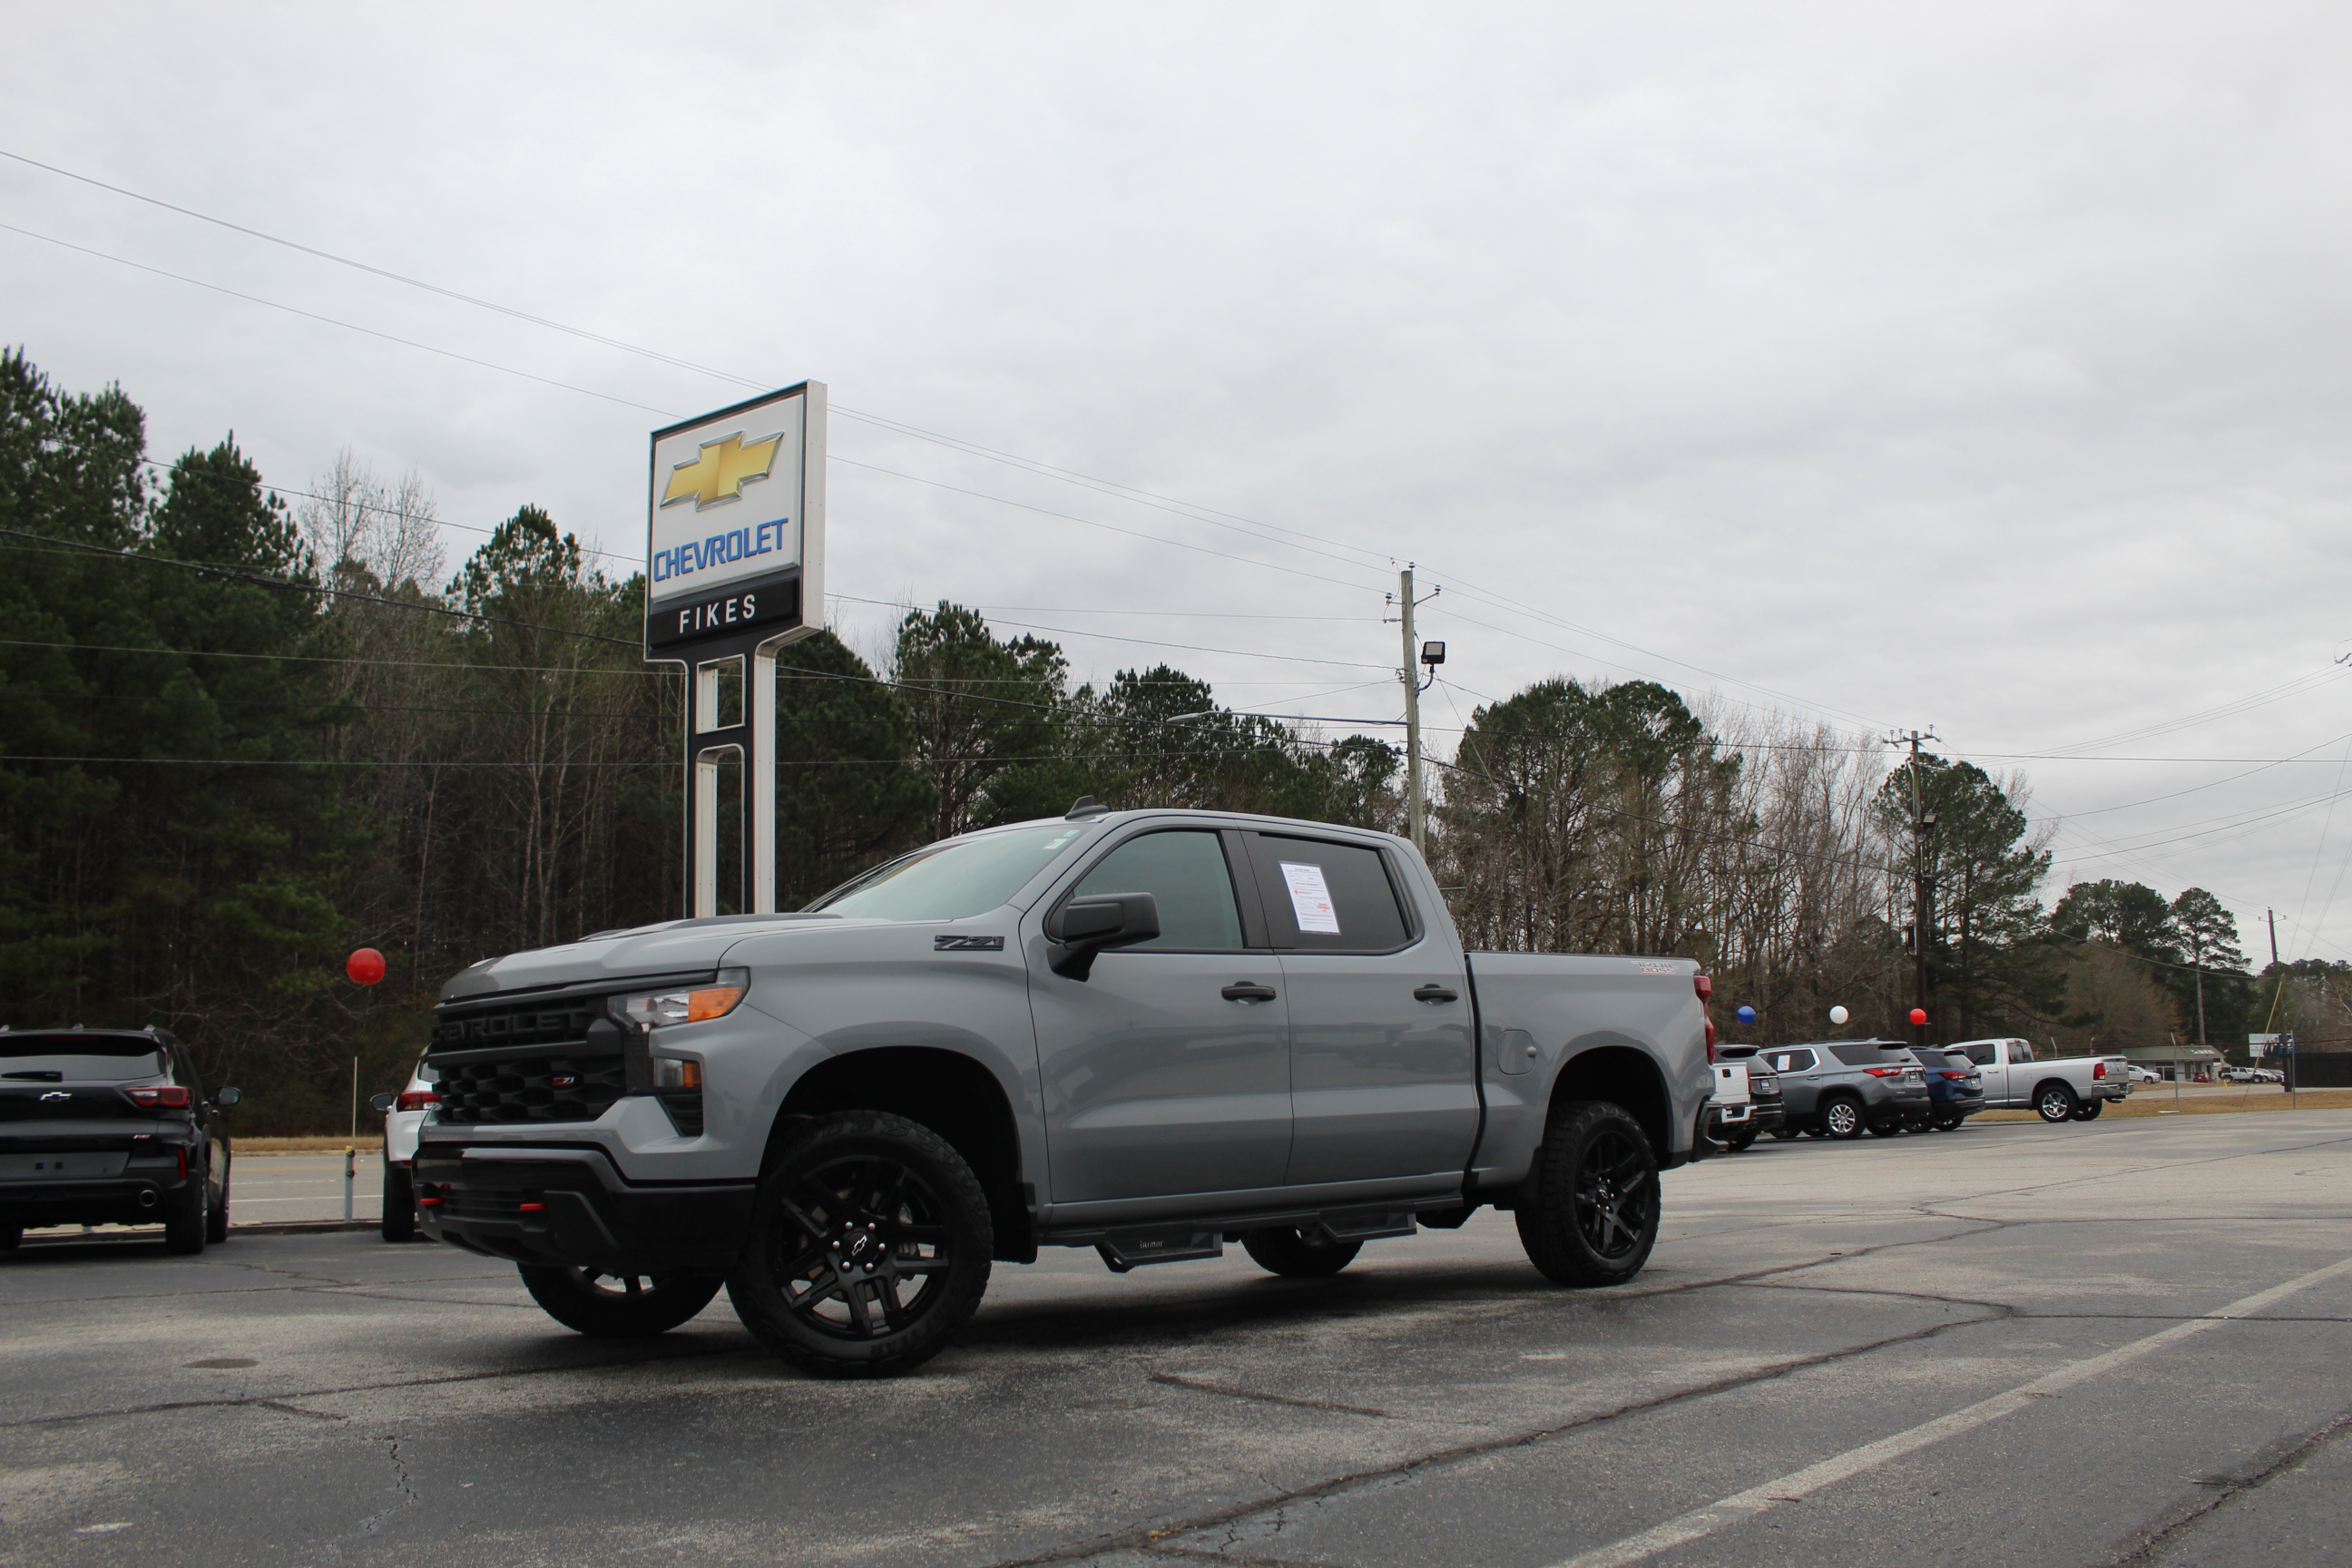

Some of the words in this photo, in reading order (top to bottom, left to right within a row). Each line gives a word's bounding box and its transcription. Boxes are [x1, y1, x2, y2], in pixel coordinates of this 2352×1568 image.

[654, 517, 789, 582] CHEVROLET
[680, 594, 757, 633] FIKES
[934, 935, 1004, 951] Z71
[431, 1008, 586, 1043] CHEVROLET
